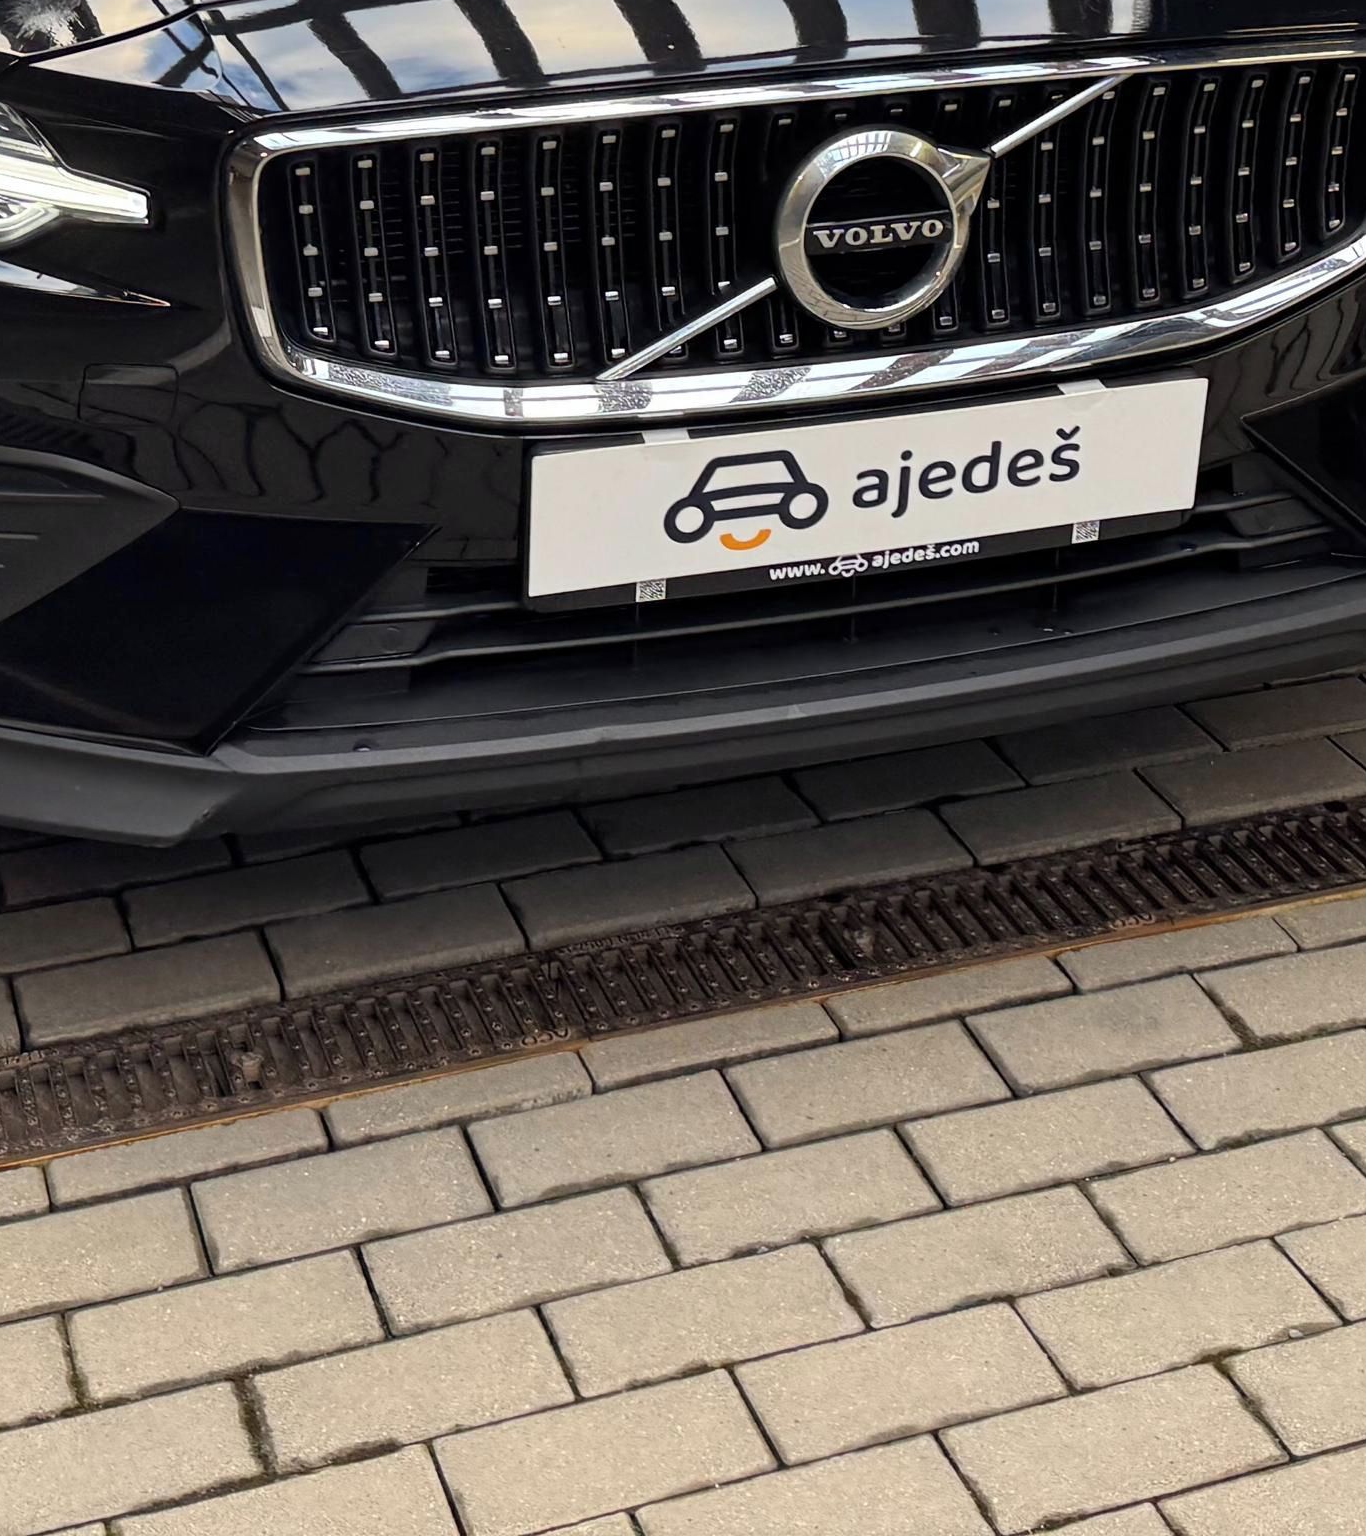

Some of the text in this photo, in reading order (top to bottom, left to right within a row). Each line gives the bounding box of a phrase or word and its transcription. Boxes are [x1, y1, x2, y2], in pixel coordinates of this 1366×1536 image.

[812, 218, 944, 249] VOLVO
[851, 425, 1082, 518] ajedeš
[769, 540, 980, 581] www. ajedeš.com
